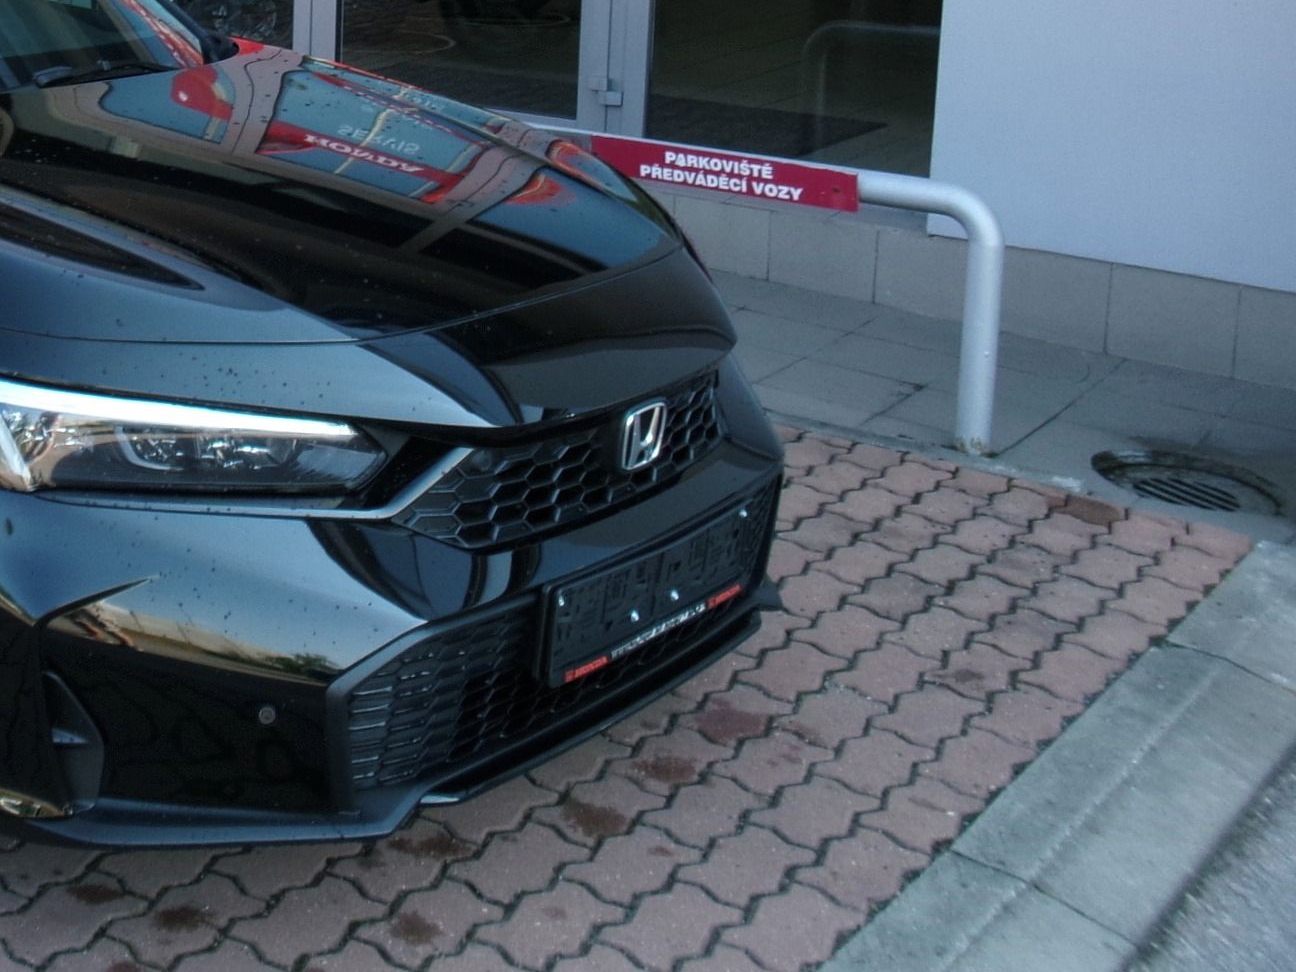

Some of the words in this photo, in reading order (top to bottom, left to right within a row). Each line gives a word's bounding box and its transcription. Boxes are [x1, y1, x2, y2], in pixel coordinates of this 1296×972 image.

[664, 150, 773, 180] PARKOVIŠTĚ
[640, 164, 748, 193] PŘEDVÁDĚCÍ
[751, 181, 803, 201] VOZY
